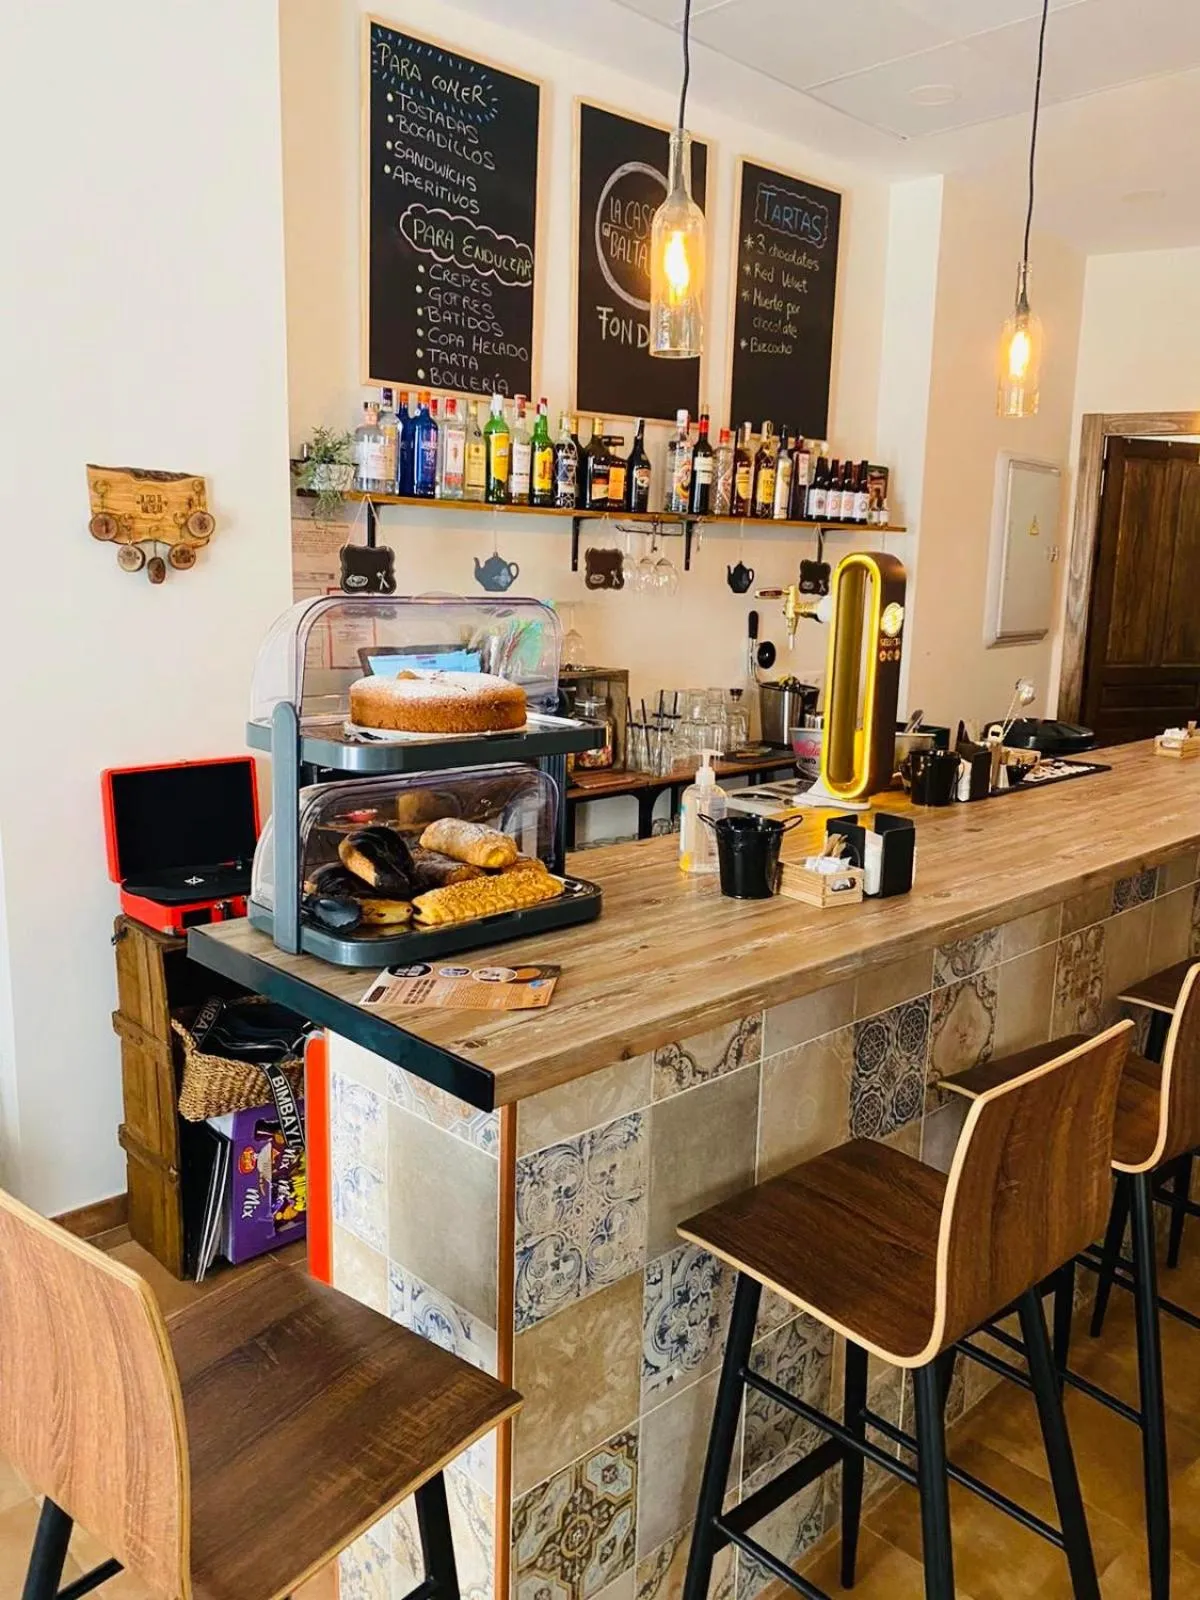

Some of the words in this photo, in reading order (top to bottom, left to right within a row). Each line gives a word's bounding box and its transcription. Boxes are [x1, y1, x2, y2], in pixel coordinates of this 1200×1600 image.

[376, 42, 423, 82] PARA
[431, 74, 487, 108] COMER
[396, 91, 479, 144] TOSTADAS
[395, 114, 496, 170] BOCADILLOS
[394, 141, 477, 192] SANDWICHS
[392, 165, 480, 214] APERITIVOS
[610, 196, 622, 224] LA
[760, 189, 822, 241] TARTAS
[413, 218, 455, 250] PARA
[756, 233, 766, 255] 3
[768, 243, 820, 272] chocolates
[428, 263, 492, 297] CREPES
[754, 262, 775, 283] Red
[428, 286, 495, 320] GOFRES
[424, 305, 504, 337] BATIDOS
[427, 326, 465, 347] COPA
[472, 335, 529, 361] HELADO
[427, 348, 479, 370] TARTA
